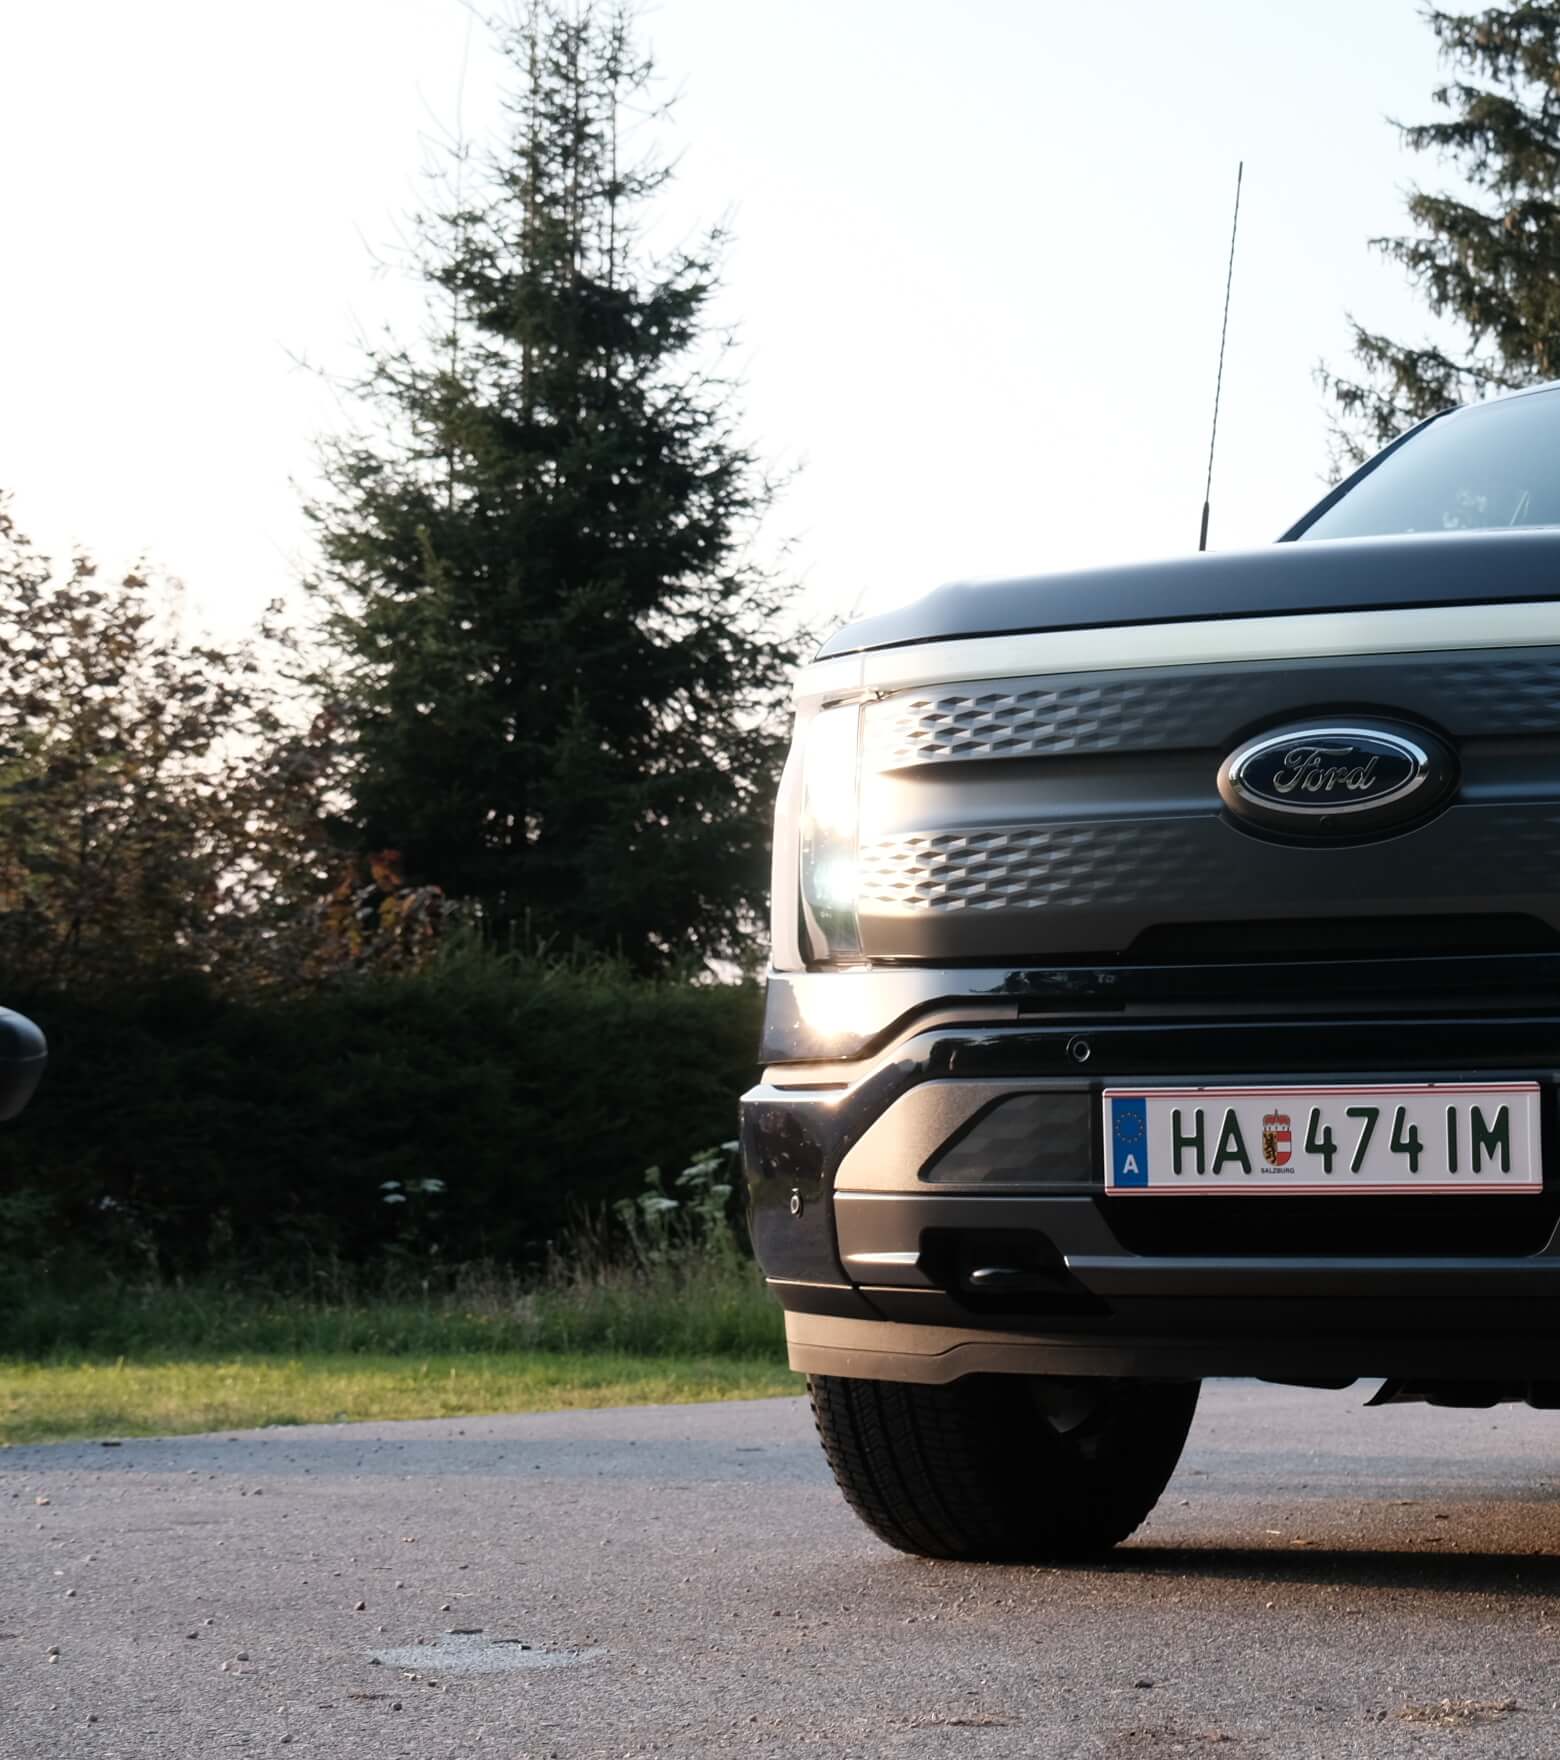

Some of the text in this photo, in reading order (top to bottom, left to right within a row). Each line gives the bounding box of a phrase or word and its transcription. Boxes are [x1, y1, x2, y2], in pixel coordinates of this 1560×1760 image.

[1273, 746, 1379, 793] Ford
[1171, 1104, 1511, 1175] HA 474 IM
[1122, 1153, 1140, 1174] A
